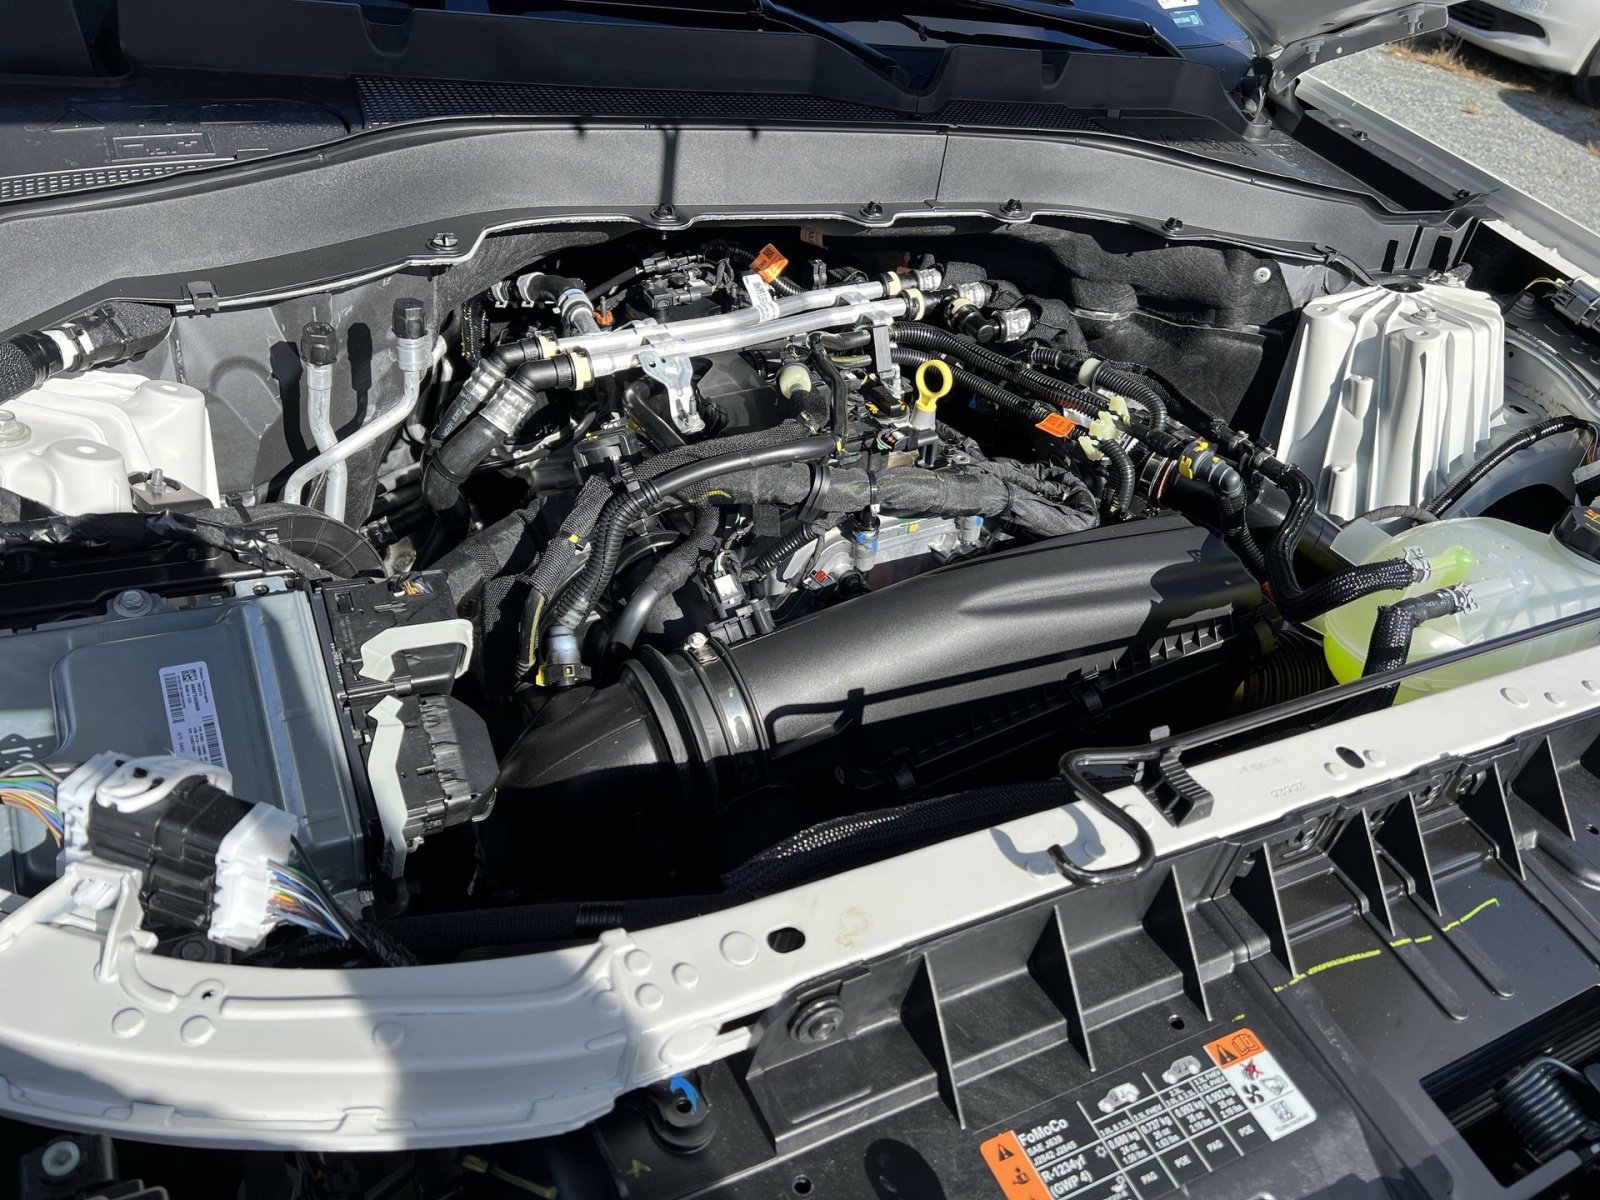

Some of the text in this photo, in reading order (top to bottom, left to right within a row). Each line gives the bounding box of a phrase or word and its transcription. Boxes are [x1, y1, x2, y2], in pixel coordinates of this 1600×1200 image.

[1223, 1086, 1236, 1097] kg
[1193, 1100, 1206, 1110] kg
[1158, 1116, 1173, 1126] kg
[1018, 1119, 1069, 1146] FoMoCo
[1127, 1130, 1140, 1141] kg
[1238, 1124, 1255, 1137] POE
[1027, 1142, 1045, 1156] SAE
[1206, 1139, 1224, 1153] PAG
[1041, 1154, 1087, 1183] R-1234yf
[1174, 1154, 1192, 1170] POE
[1050, 1170, 1093, 1198] (GWP 4)
[1140, 1171, 1159, 1185] PAG
